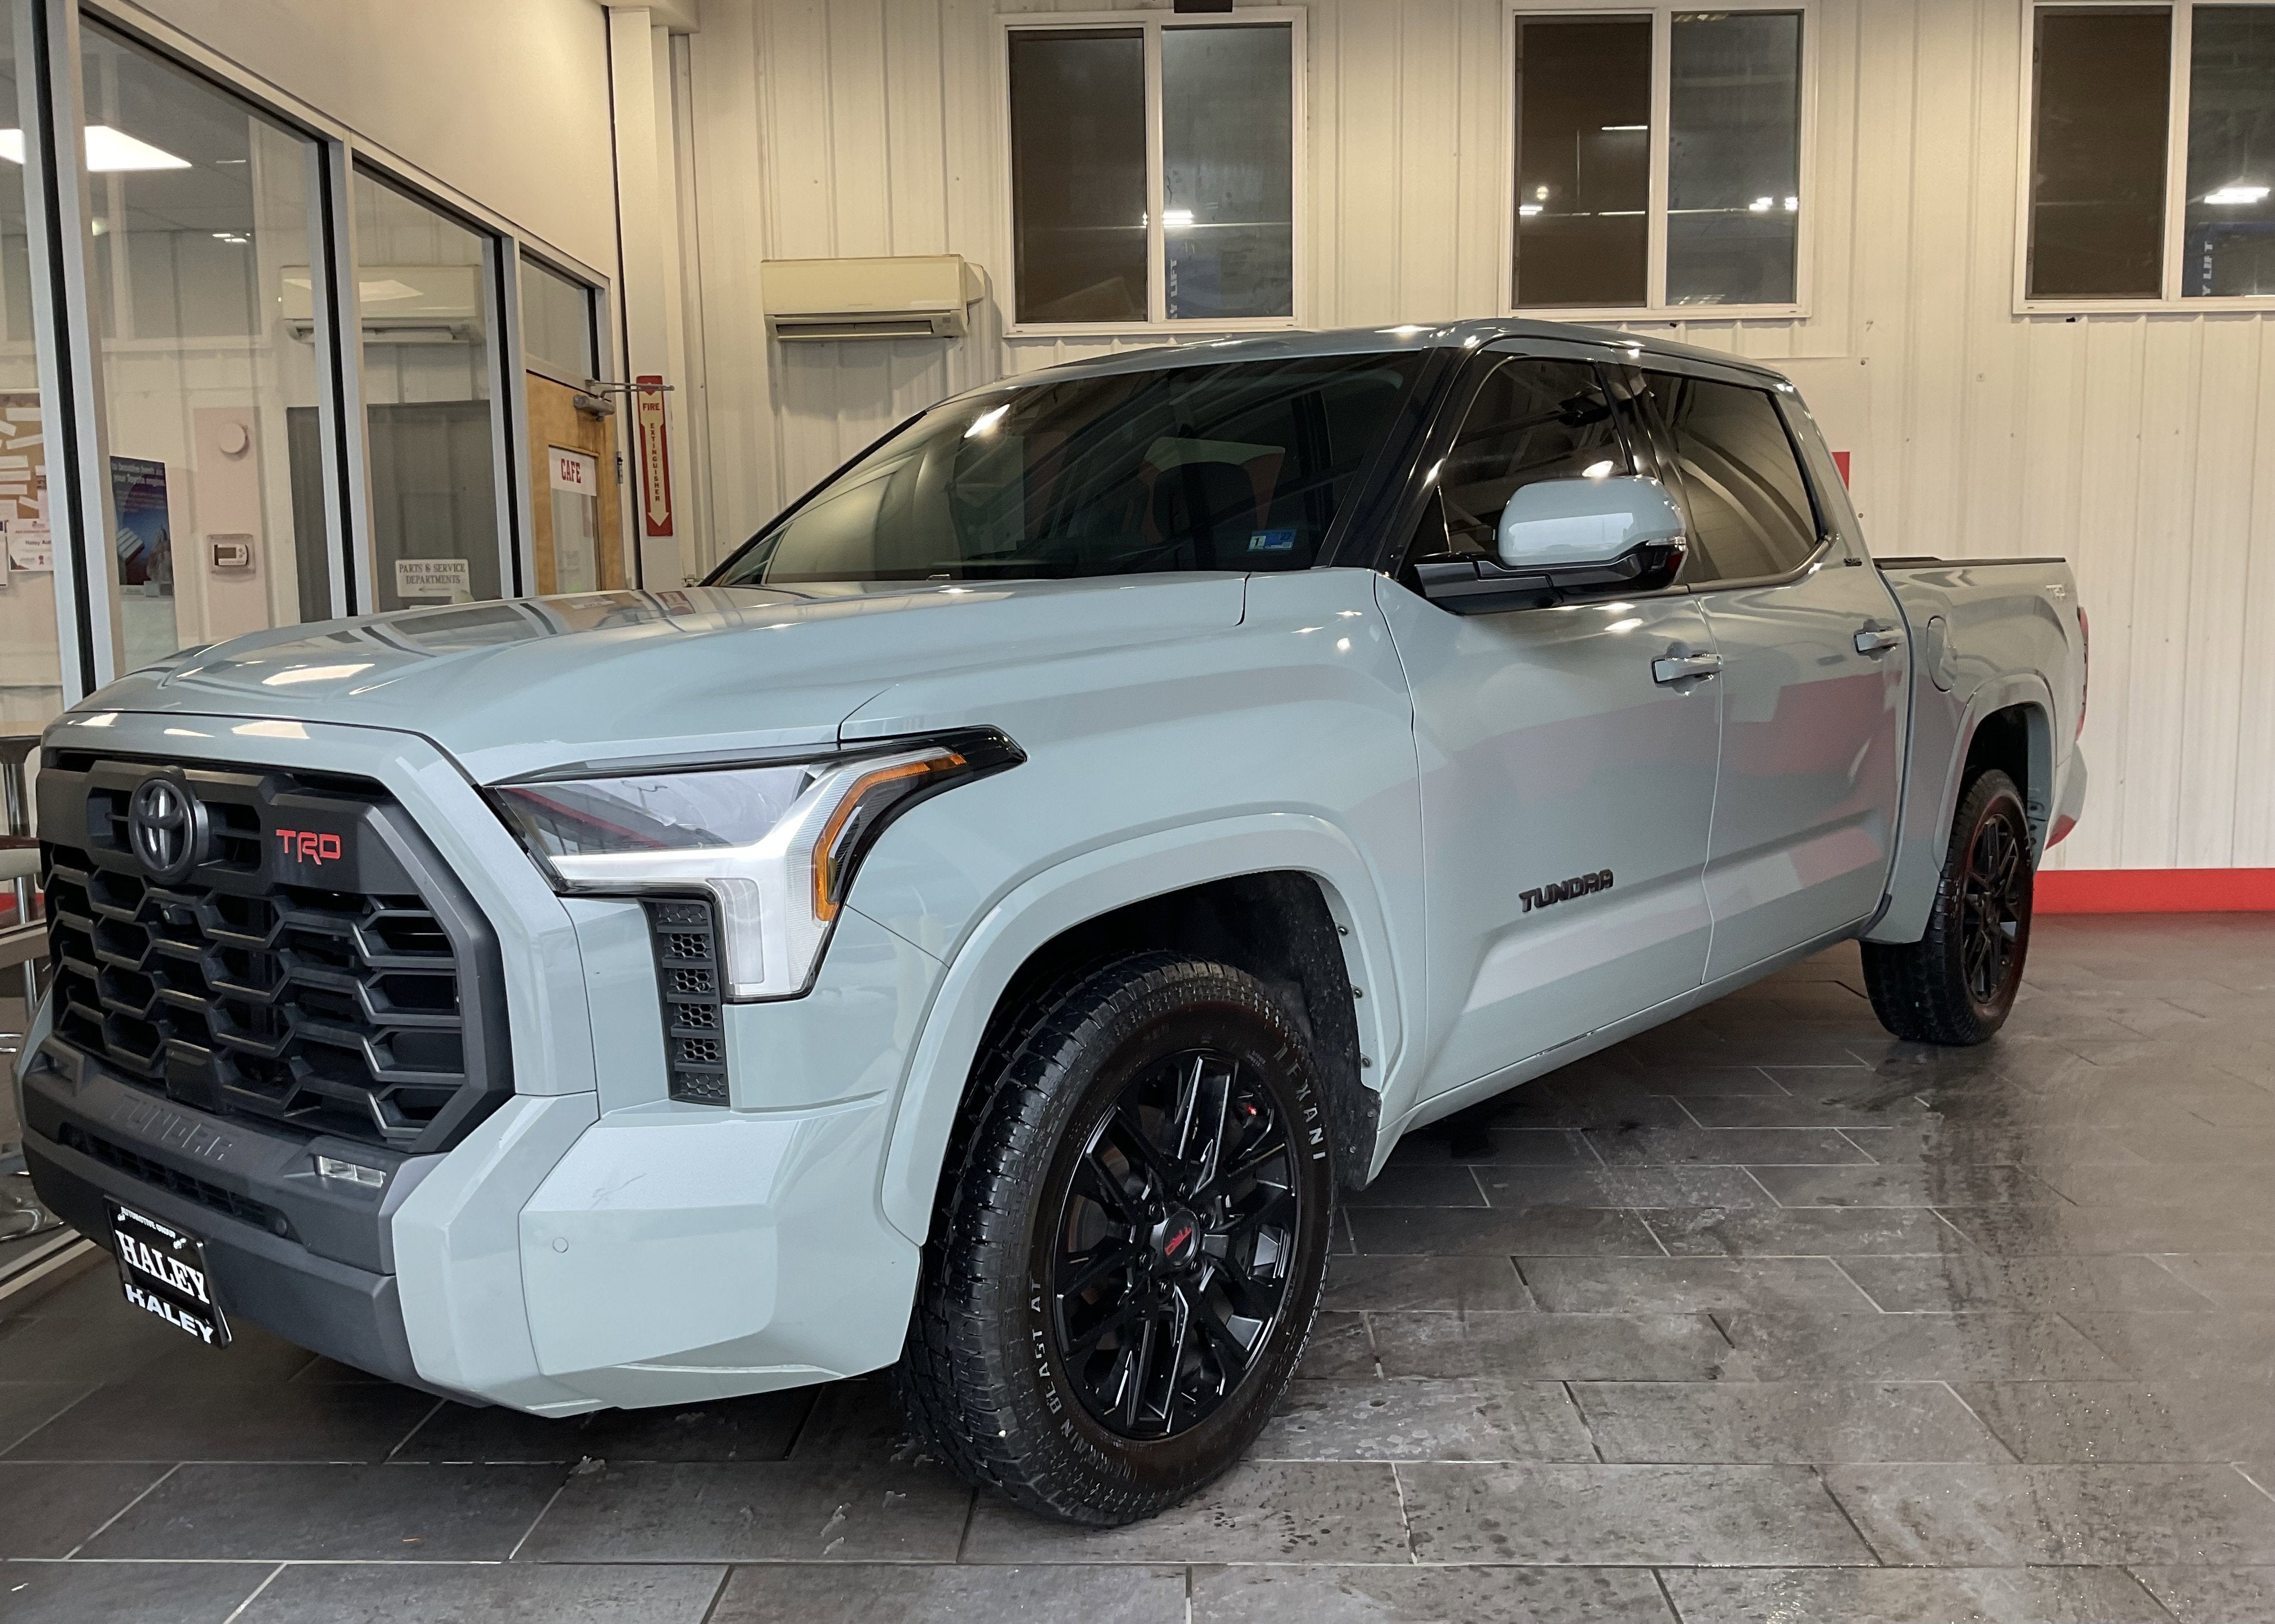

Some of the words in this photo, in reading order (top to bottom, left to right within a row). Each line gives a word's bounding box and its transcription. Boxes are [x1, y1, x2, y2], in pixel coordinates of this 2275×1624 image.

[2203, 241, 2212, 279] LIFT
[643, 403, 660, 411] FIRE
[561, 458, 581, 483] CAFE
[649, 422, 660, 501] EXTINGUISHER
[1254, 536, 1261, 547] 1
[399, 564, 423, 573] PARTS
[425, 564, 431, 573] &
[433, 563, 465, 573] SERVICE
[406, 575, 460, 584] DEPARTMENTS
[275, 829, 341, 865] TRD
[1519, 869, 1614, 913] TUNDRA
[115, 1229, 210, 1304] HALEY
[1029, 1276, 1041, 1313] AT
[125, 1283, 214, 1344] HALEY
[1031, 1328, 1062, 1414] BEAST
